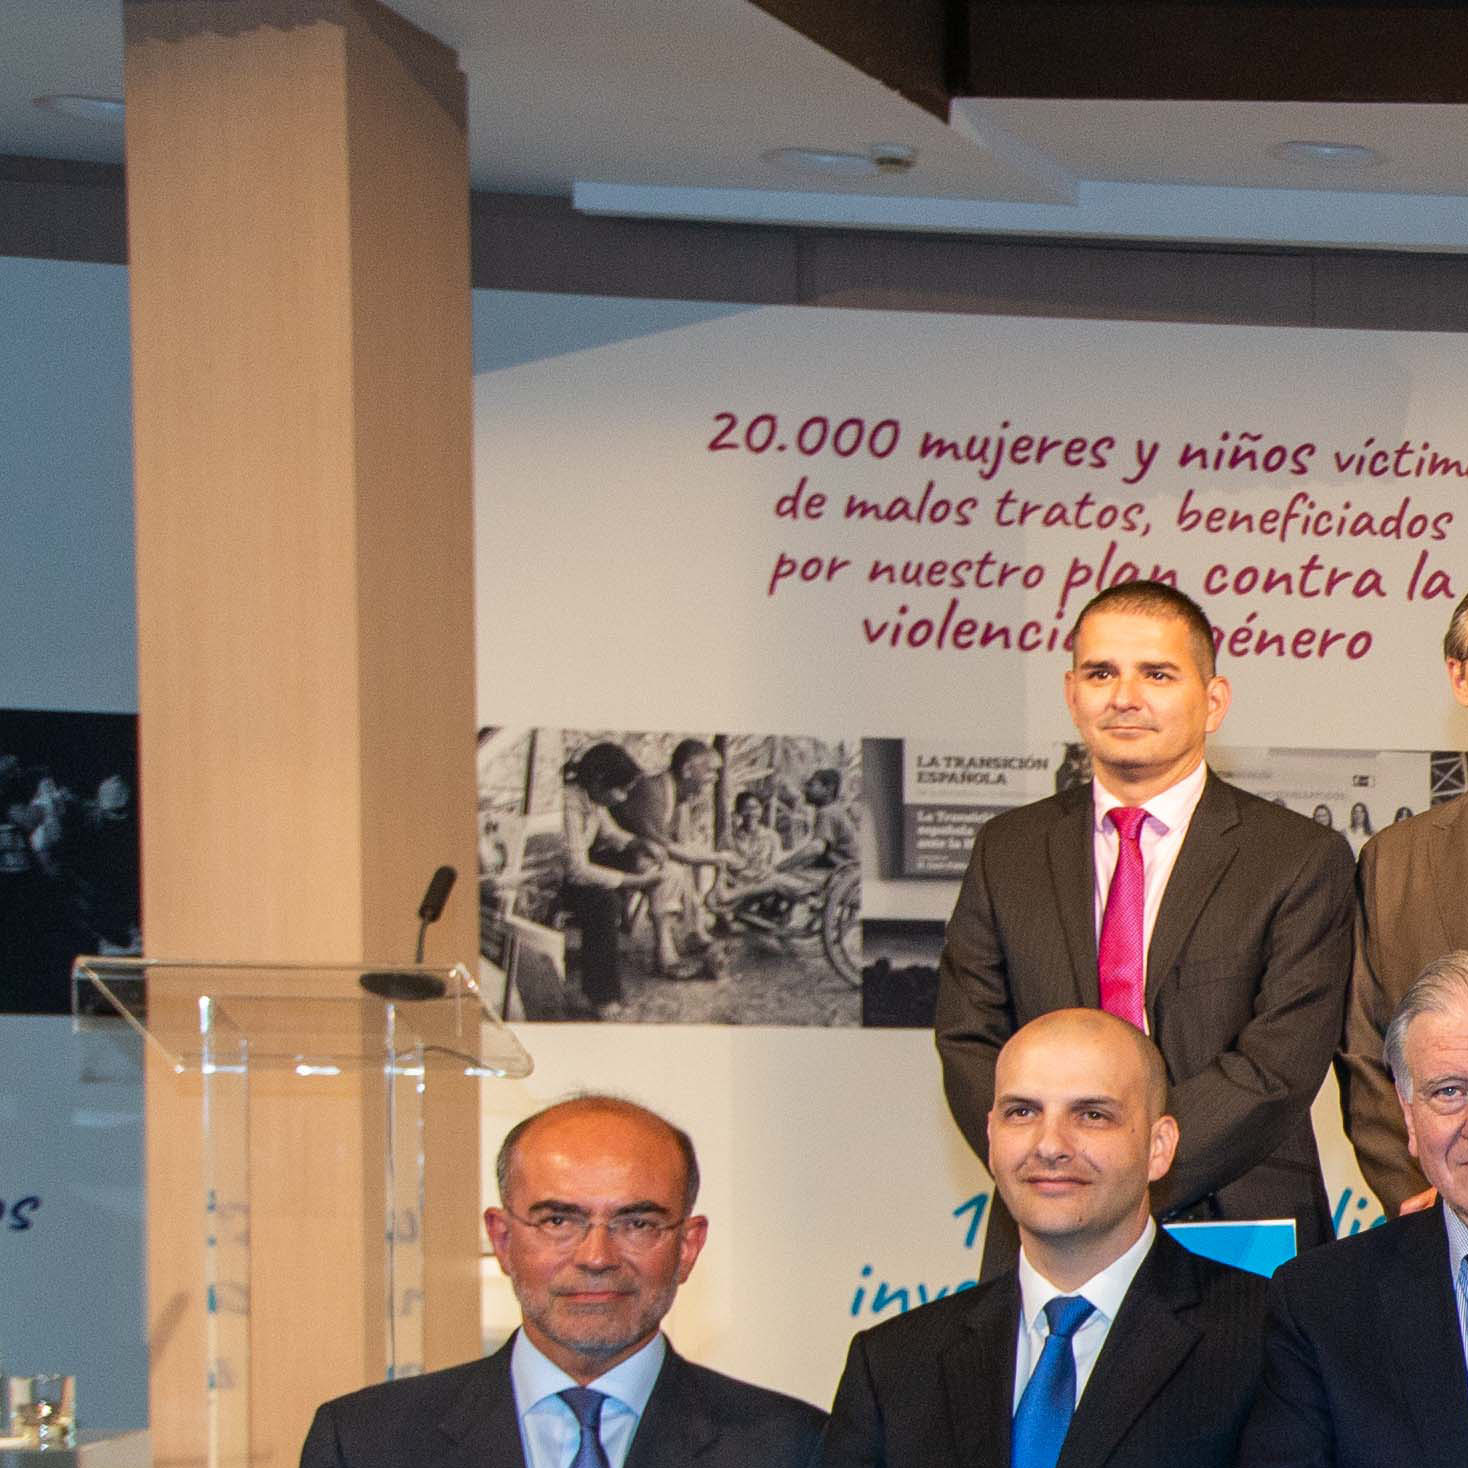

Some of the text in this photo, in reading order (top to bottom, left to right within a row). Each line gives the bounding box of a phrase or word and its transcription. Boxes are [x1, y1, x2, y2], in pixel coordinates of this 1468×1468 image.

[706, 410, 902, 461] 20.000
[918, 420, 1117, 482] mujeres
[1120, 438, 1161, 486] y
[1176, 430, 1318, 478] niños
[774, 475, 1457, 544] de malos tratos, beneficiados
[767, 551, 851, 600] por
[867, 549, 1046, 591] nuestro
[1202, 554, 1388, 602] contra
[1405, 549, 1458, 602] la
[916, 753, 1048, 770] LA TRANSICIÓN
[916, 770, 1007, 785] ESPAÑOLA
